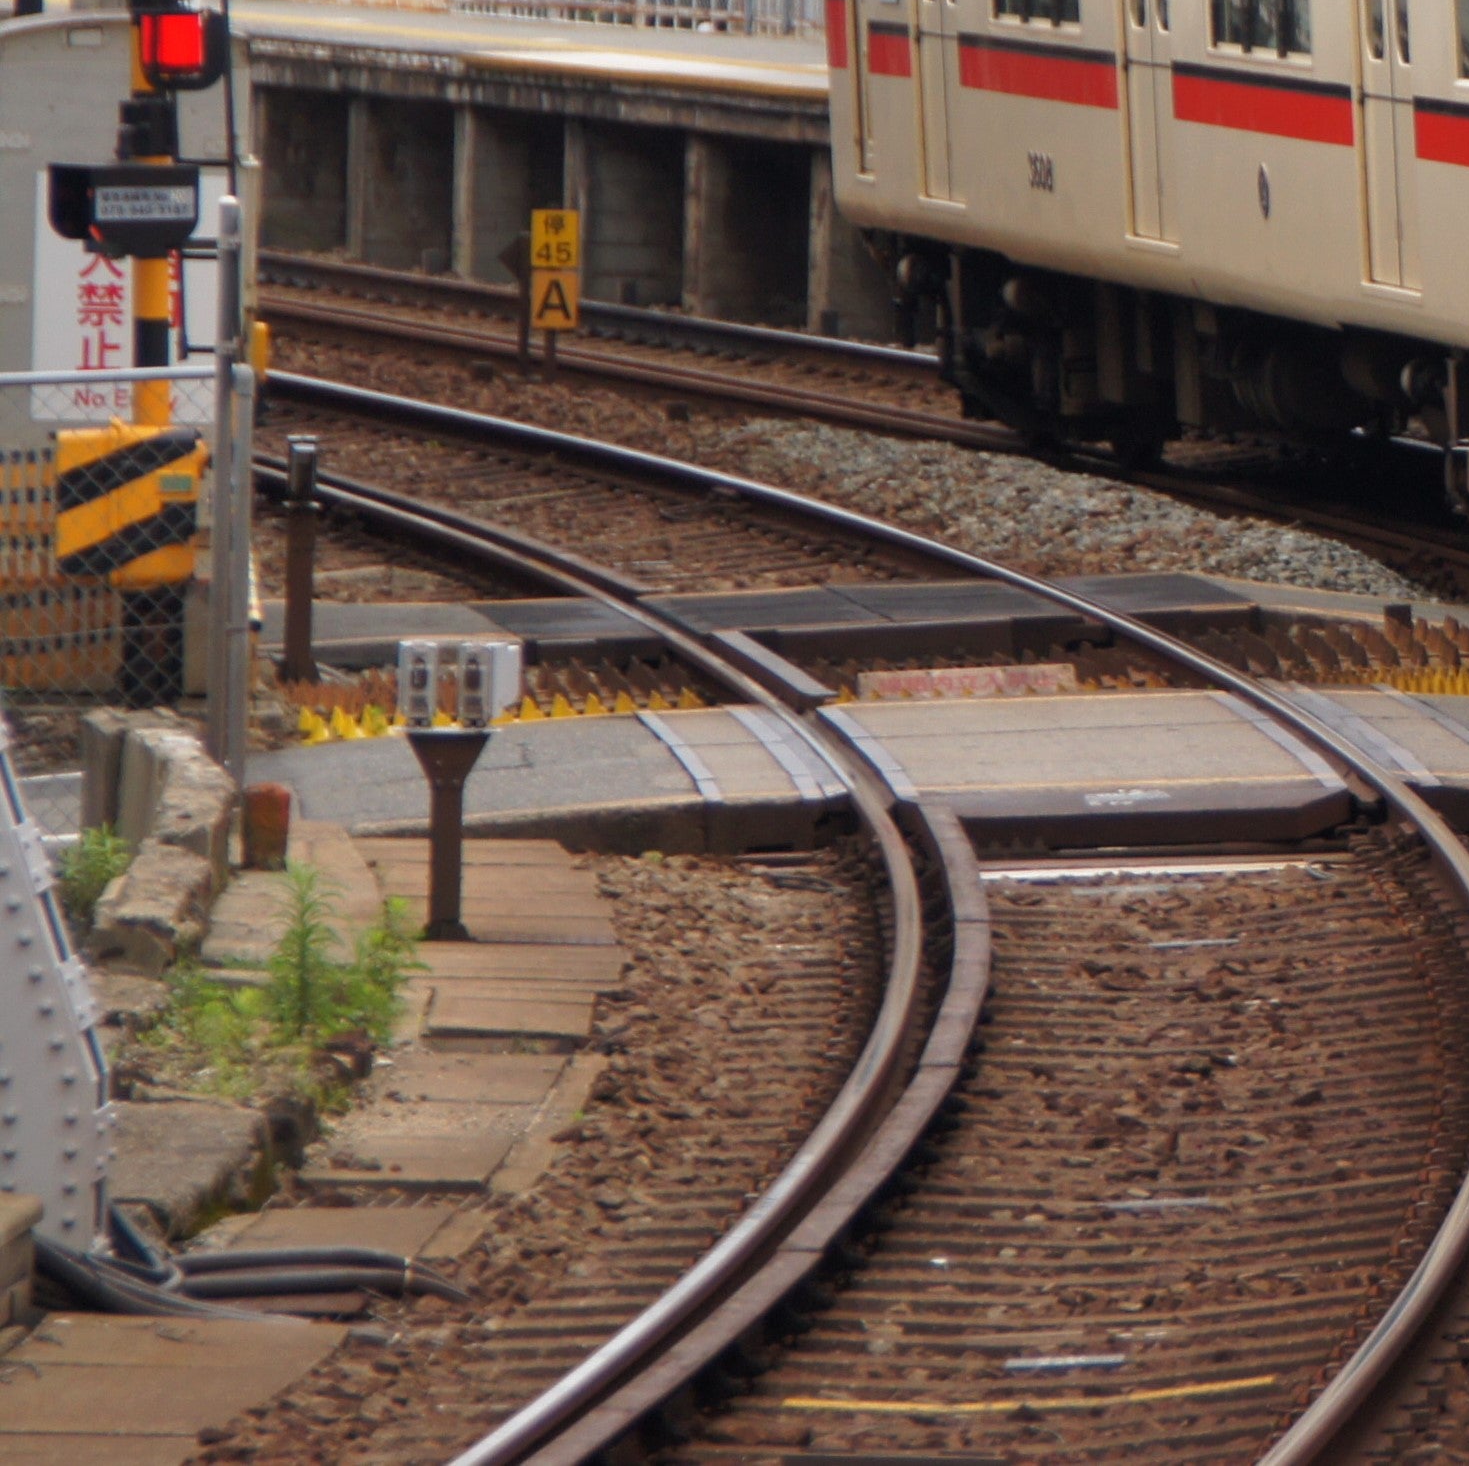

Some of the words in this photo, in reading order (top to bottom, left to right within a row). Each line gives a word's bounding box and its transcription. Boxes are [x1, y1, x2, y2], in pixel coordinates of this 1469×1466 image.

[536, 241, 571, 263] 45
[536, 279, 571, 320] A
[75, 389, 106, 408] No
